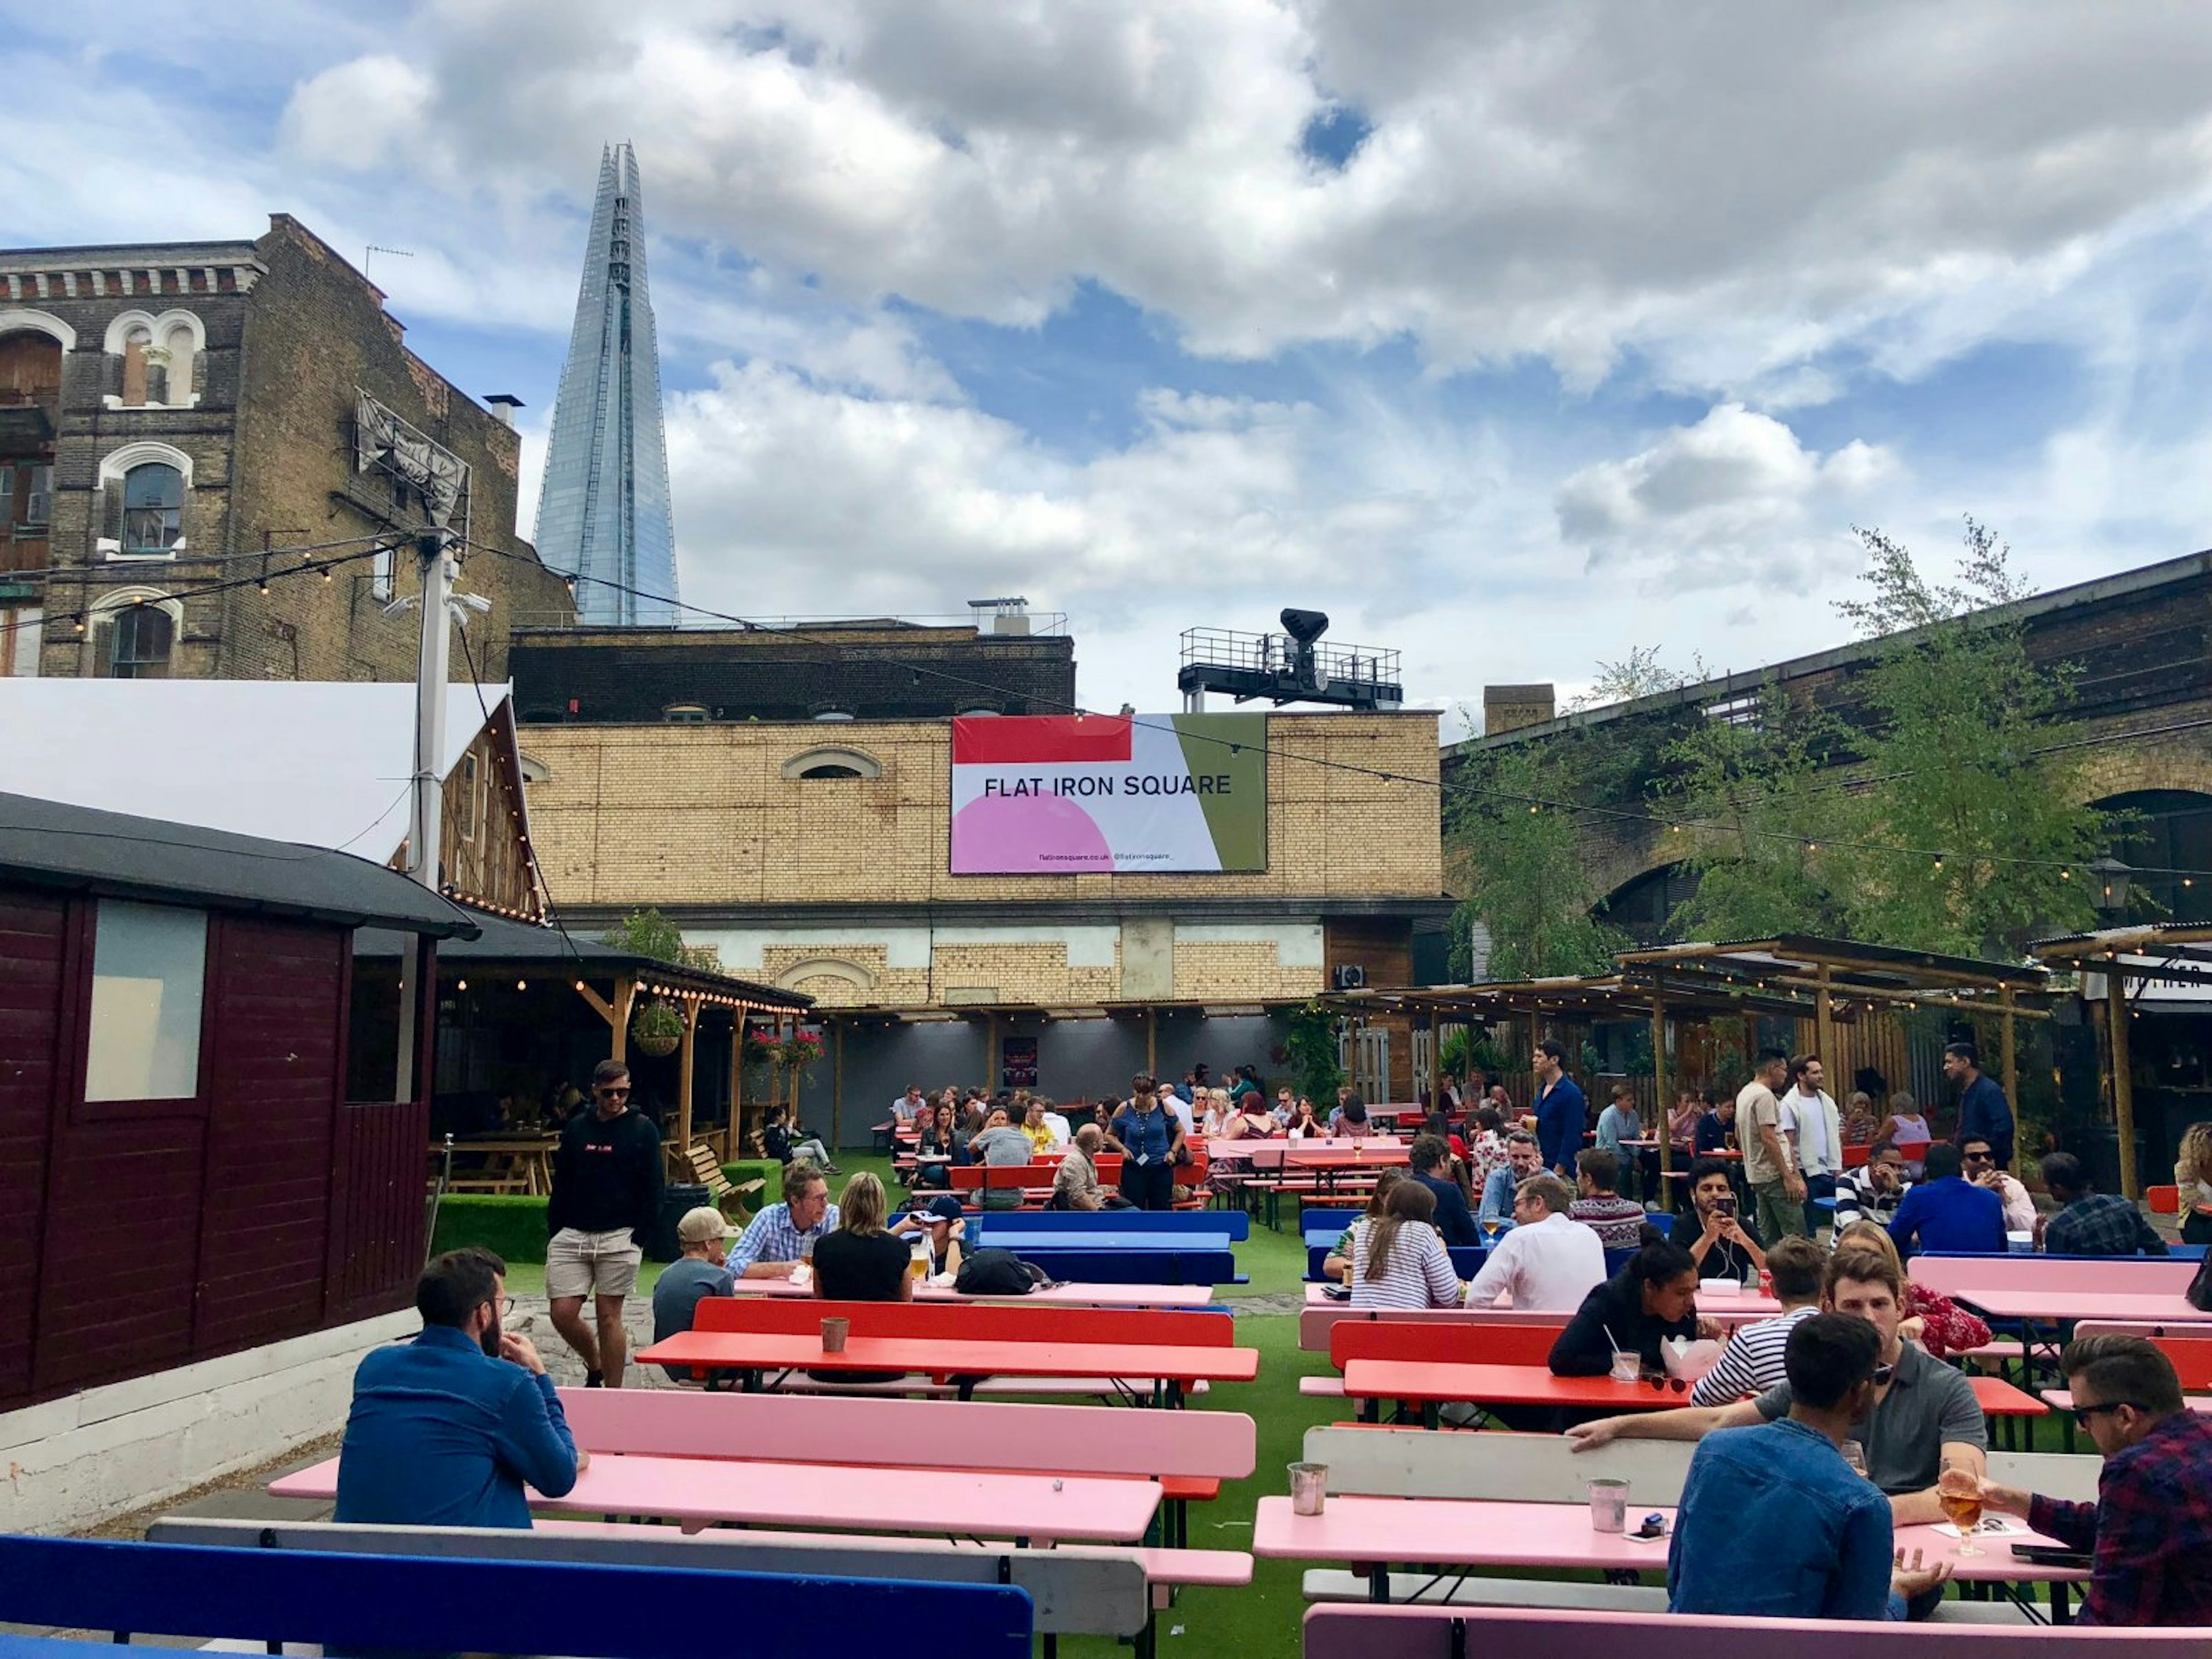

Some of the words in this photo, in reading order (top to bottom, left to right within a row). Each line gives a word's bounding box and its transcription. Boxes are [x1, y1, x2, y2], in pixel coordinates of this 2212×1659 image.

[985, 778, 1043, 797] FLAT
[1054, 777, 1113, 796] IRON
[1124, 775, 1231, 795] SQUARE
